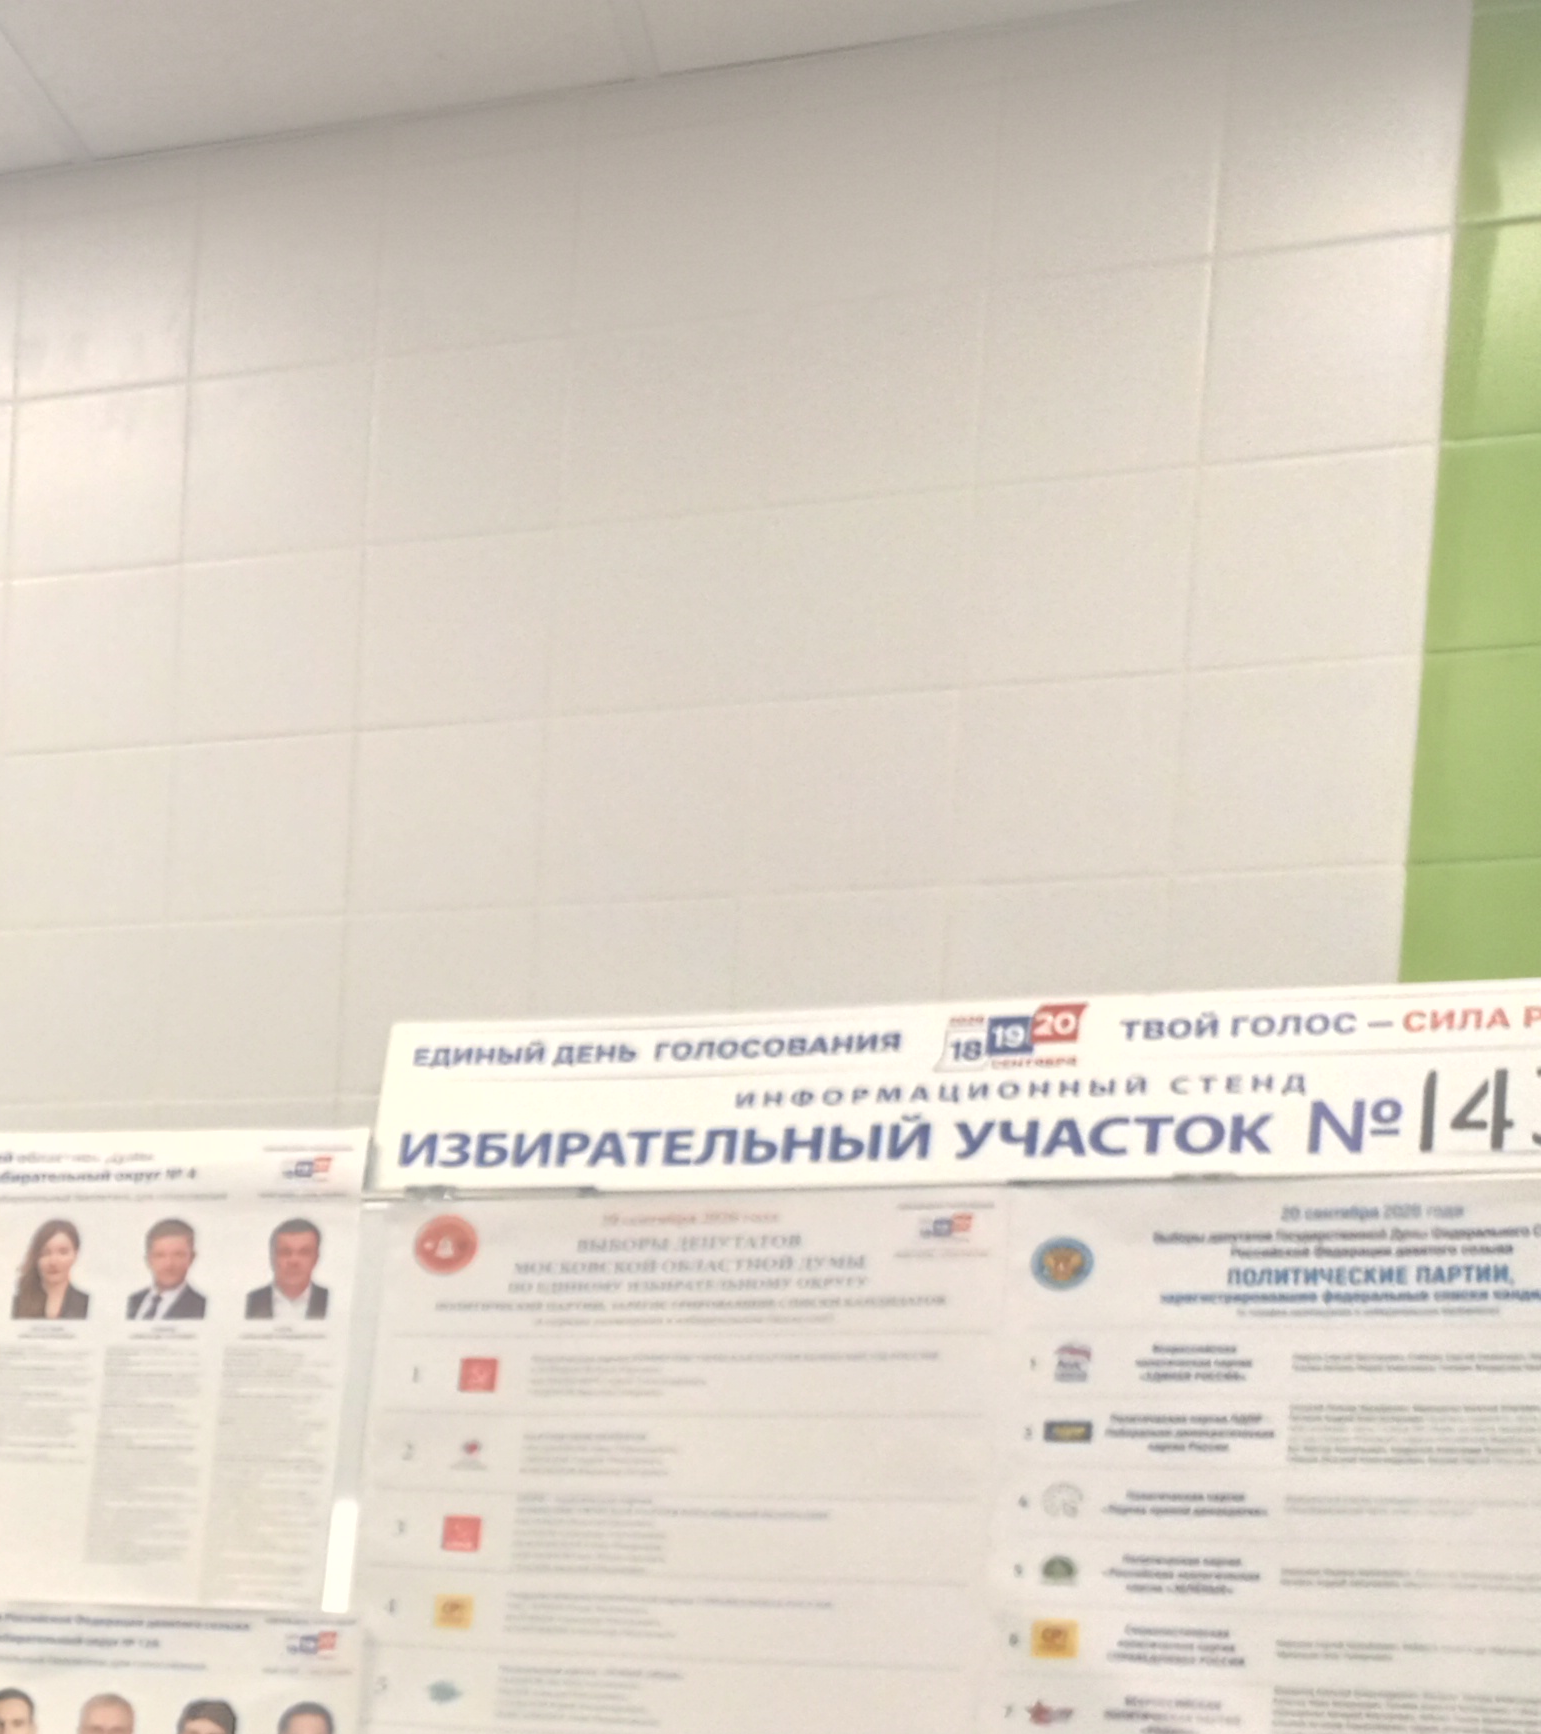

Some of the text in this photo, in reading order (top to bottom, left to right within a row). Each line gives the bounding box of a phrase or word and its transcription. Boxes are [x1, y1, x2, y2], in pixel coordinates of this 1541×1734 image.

[950, 1010, 1078, 1062] 18 19 20
[1120, 1012, 1219, 1042] ТВОЙ
[1230, 1012, 1357, 1039] ГОЛОС
[1403, 1007, 1511, 1033] СИЛА
[413, 1031, 902, 1068] ЕДИНЫЙ ДЕНЬ ГОЛОСОВАНИЯ
[735, 1072, 1308, 1110] ИНФОРМАЦИОННЫЙ СТЕНД
[1419, 1067, 1541, 1154] 14
[397, 1115, 932, 1170] ИЗБИРАТЕЛЬНЫЙ
[954, 1112, 1275, 1160] УЧАСТОК
[1227, 1263, 1515, 1287] ПОЛИТИЧЕСКИЕ ПАРТИИ,
